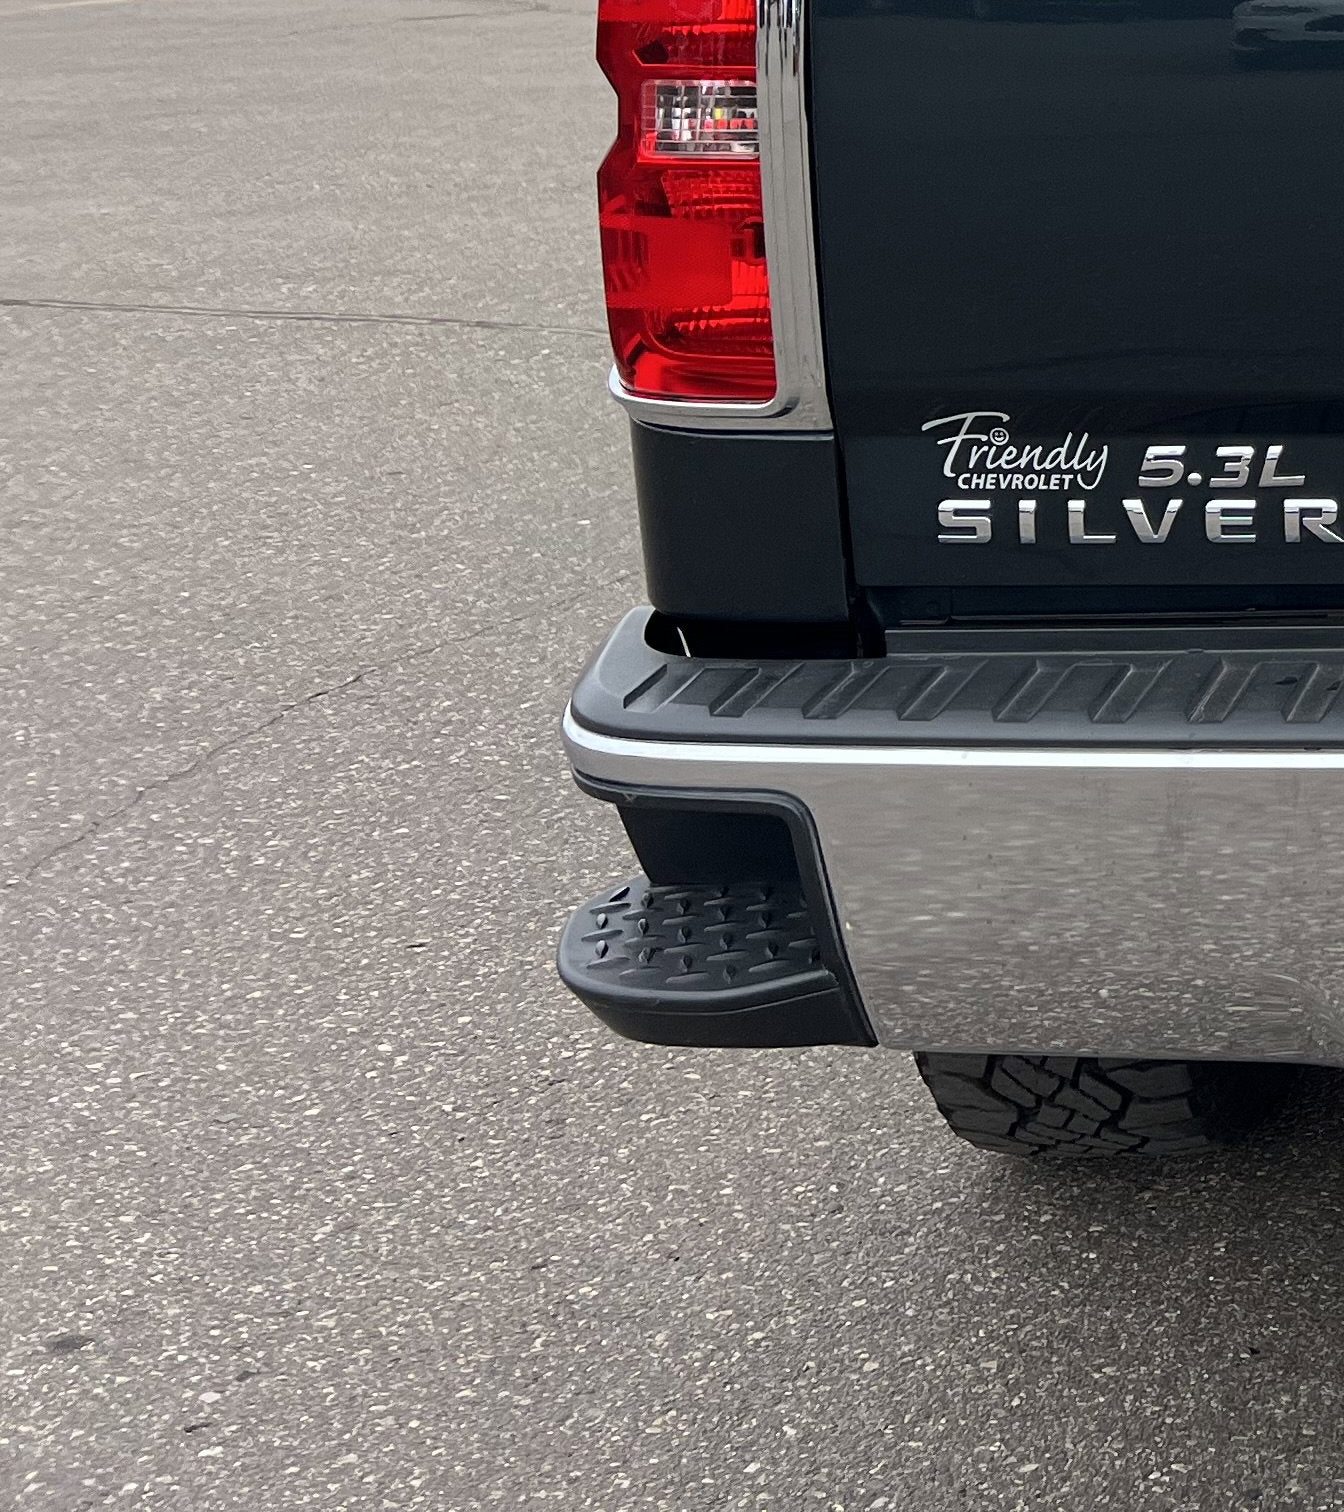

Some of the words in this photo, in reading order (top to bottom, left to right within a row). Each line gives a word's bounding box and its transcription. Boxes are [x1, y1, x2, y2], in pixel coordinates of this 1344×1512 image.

[921, 411, 1108, 490] Friendly
[1138, 445, 1305, 487] 5.3L
[957, 473, 1073, 490] CHEVROLET
